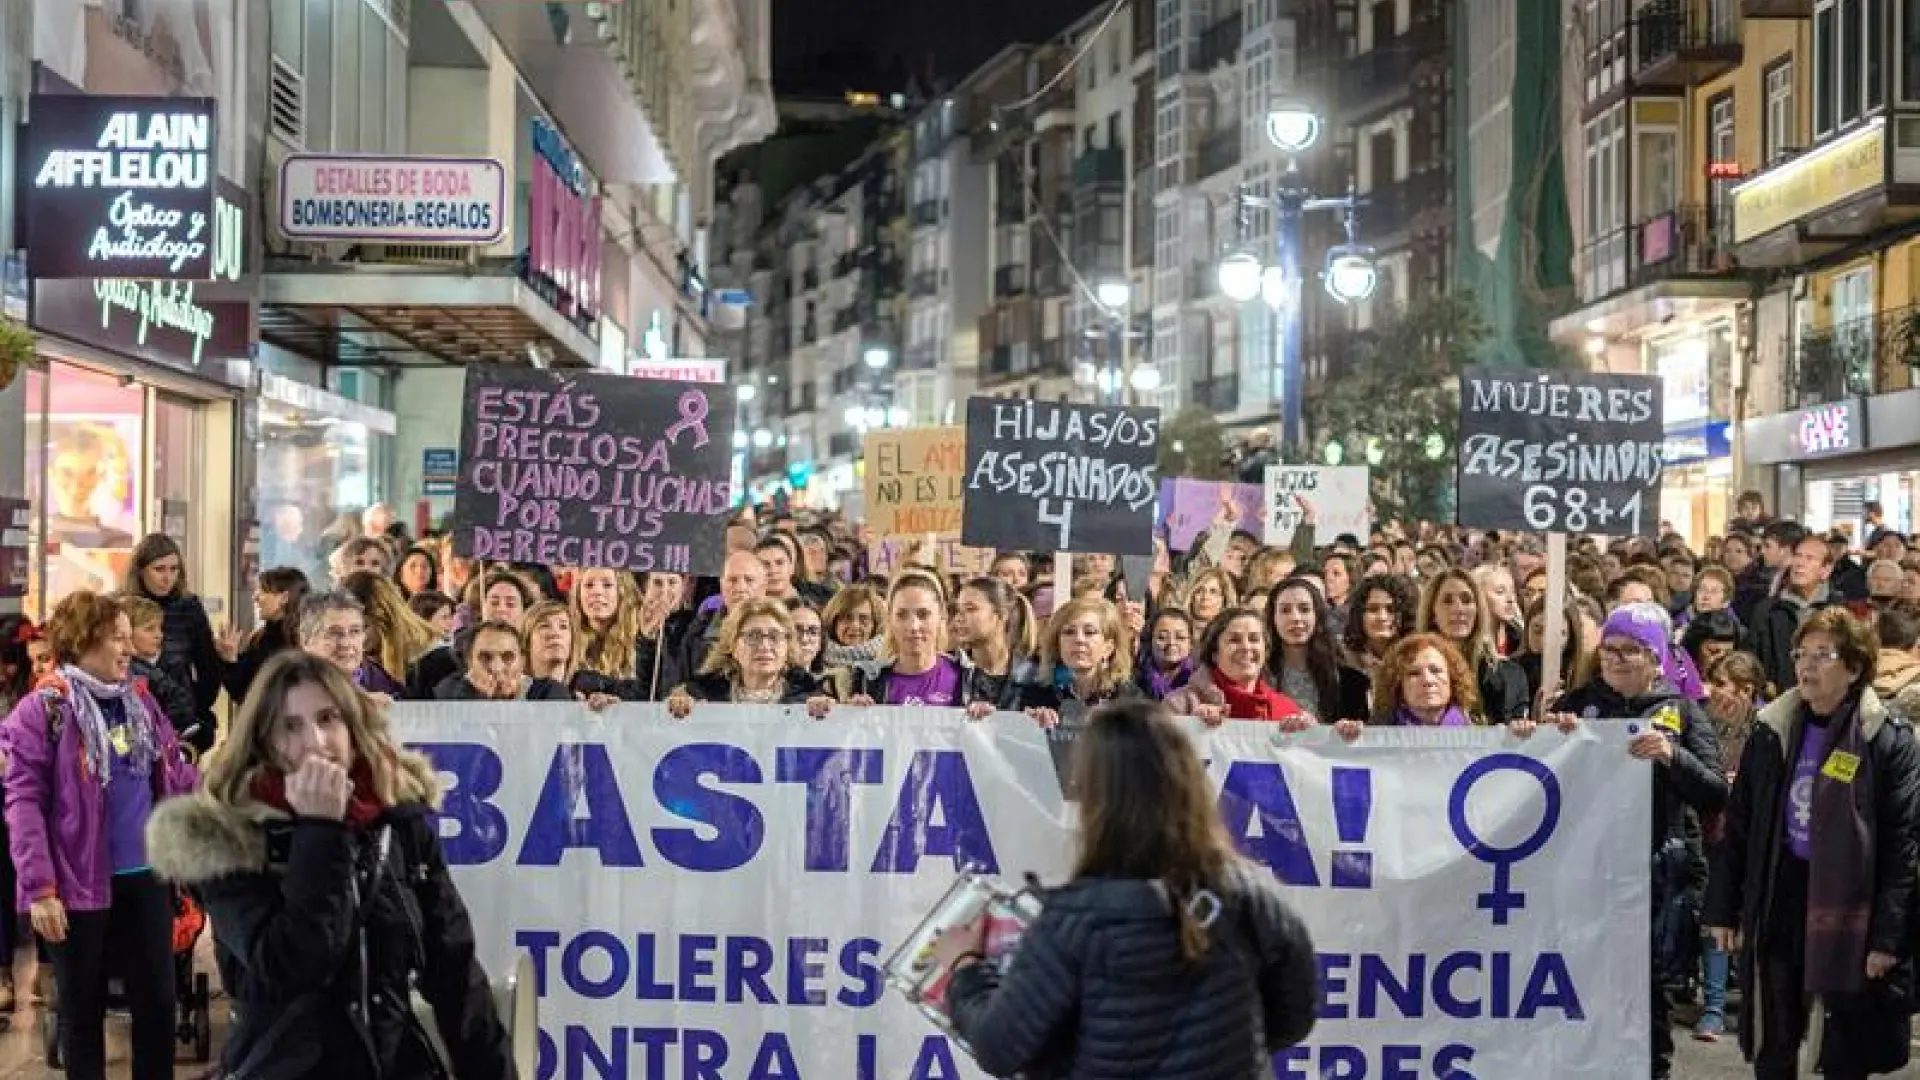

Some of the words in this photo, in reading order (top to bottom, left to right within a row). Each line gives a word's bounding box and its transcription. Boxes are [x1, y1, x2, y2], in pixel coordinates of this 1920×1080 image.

[96, 113, 209, 150] ALAIN
[35, 149, 209, 188] AFFLELOU
[316, 168, 392, 195] DETALLES
[396, 168, 417, 195] DE
[422, 170, 472, 196] BODA
[187, 211, 206, 241] y
[292, 199, 491, 230] BOMBONERIA-REGALOS
[477, 380, 601, 429] ESTÁS
[475, 423, 671, 475] PRECIOSA
[877, 442, 913, 476] EL
[472, 460, 601, 501] CUANDO
[612, 470, 733, 515] LUCHAS
[916, 475, 936, 502] ES
[1523, 484, 1642, 536] 68+1
[497, 494, 560, 532] POR
[590, 505, 664, 538] TUS
[1038, 498, 1073, 549] 4
[473, 525, 655, 573] DERECHOS
[403, 741, 1000, 875] BASTA
[515, 929, 885, 1007] TOLERES
[1314, 951, 1585, 1020] ENCIA
